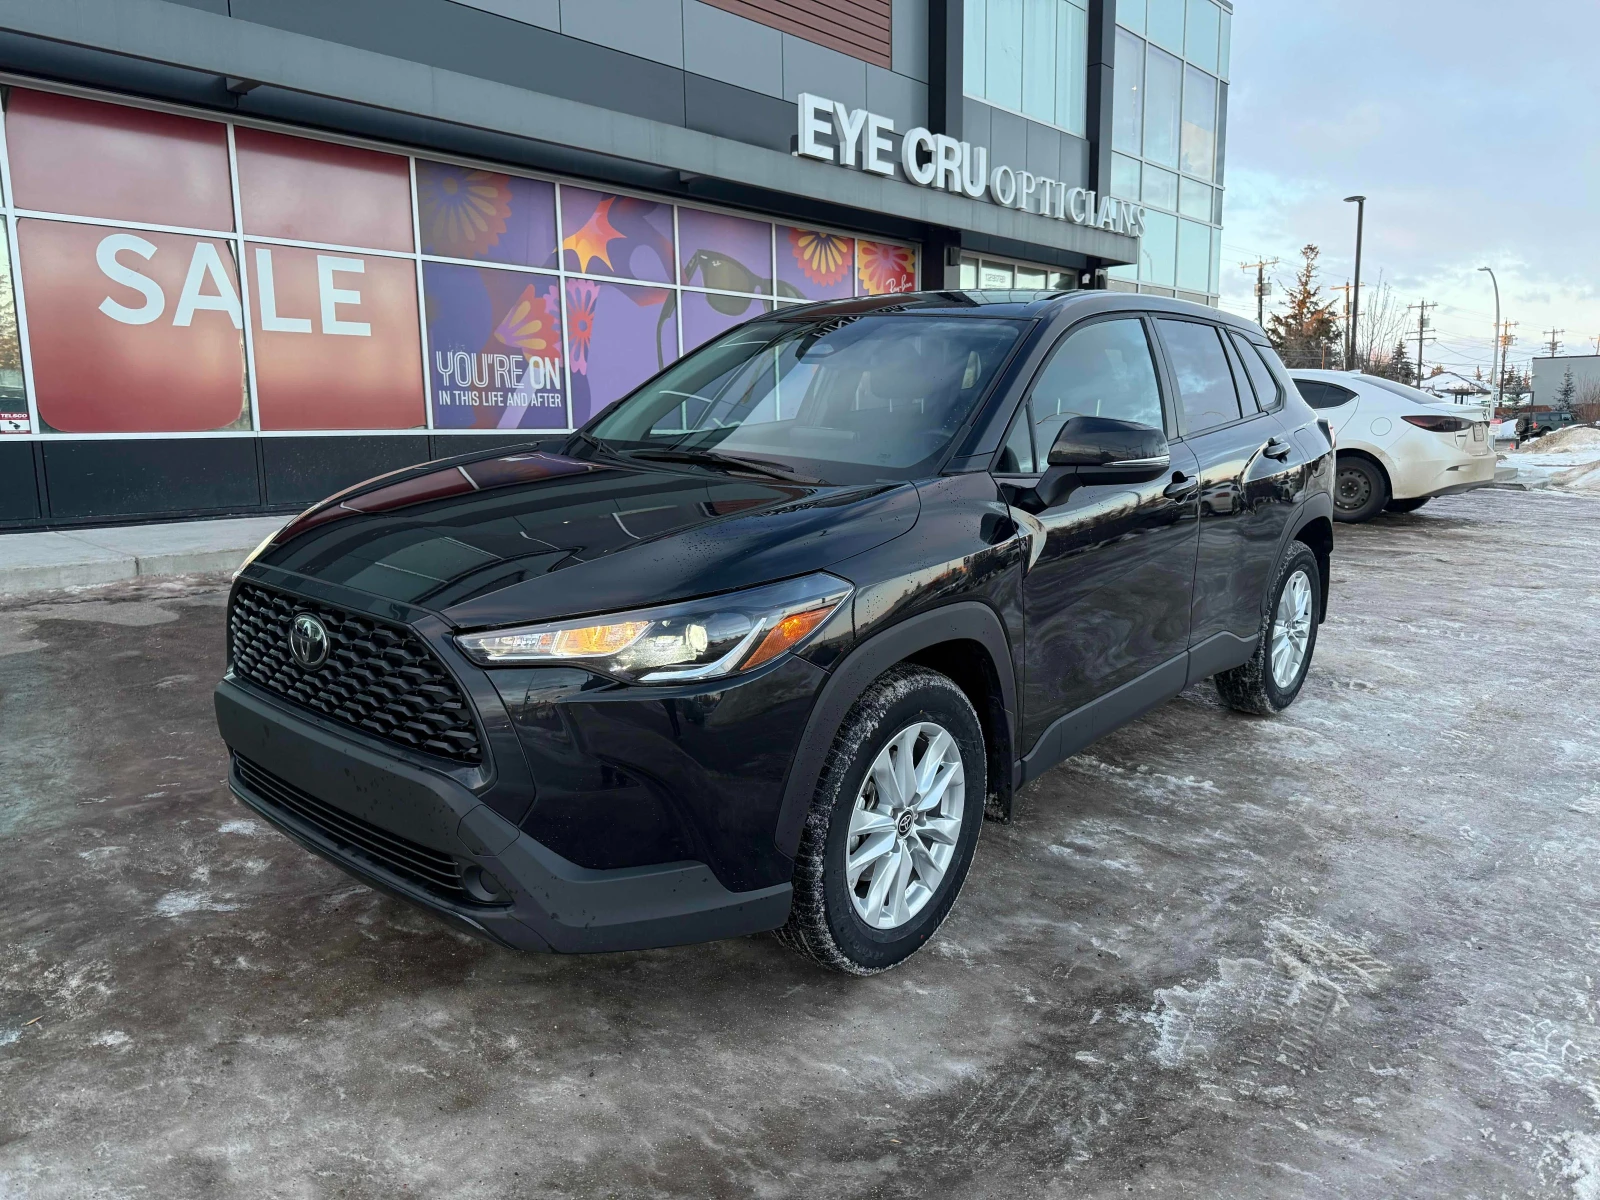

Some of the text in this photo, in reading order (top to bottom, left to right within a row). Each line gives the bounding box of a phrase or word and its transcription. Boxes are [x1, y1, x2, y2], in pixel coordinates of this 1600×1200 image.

[798, 92, 1146, 239] EYE CRU OPTICIANS
[96, 233, 372, 337] SALE
[886, 274, 912, 293] Ray-Ban
[436, 351, 561, 390] YOU'RE ON
[439, 390, 562, 408] IN THIS LIFE AND AFTER
